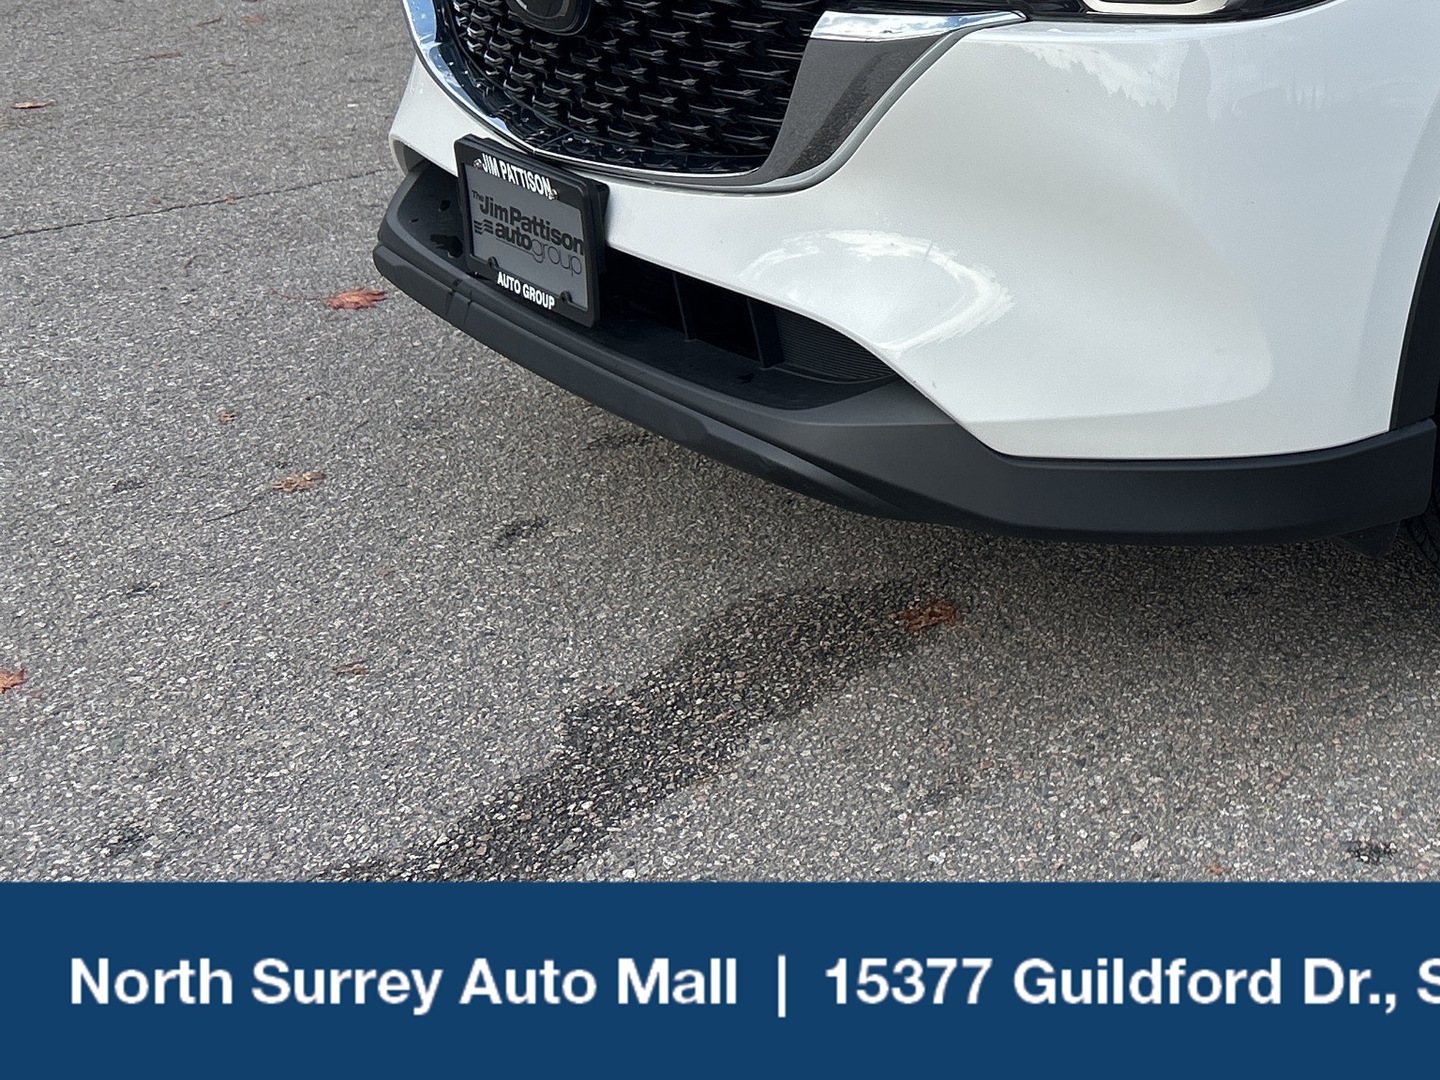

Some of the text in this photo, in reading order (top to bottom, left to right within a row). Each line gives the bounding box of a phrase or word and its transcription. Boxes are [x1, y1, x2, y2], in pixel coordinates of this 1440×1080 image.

[481, 153, 553, 198] JIM PATTISON
[497, 271, 555, 310] AUTO GROUP
